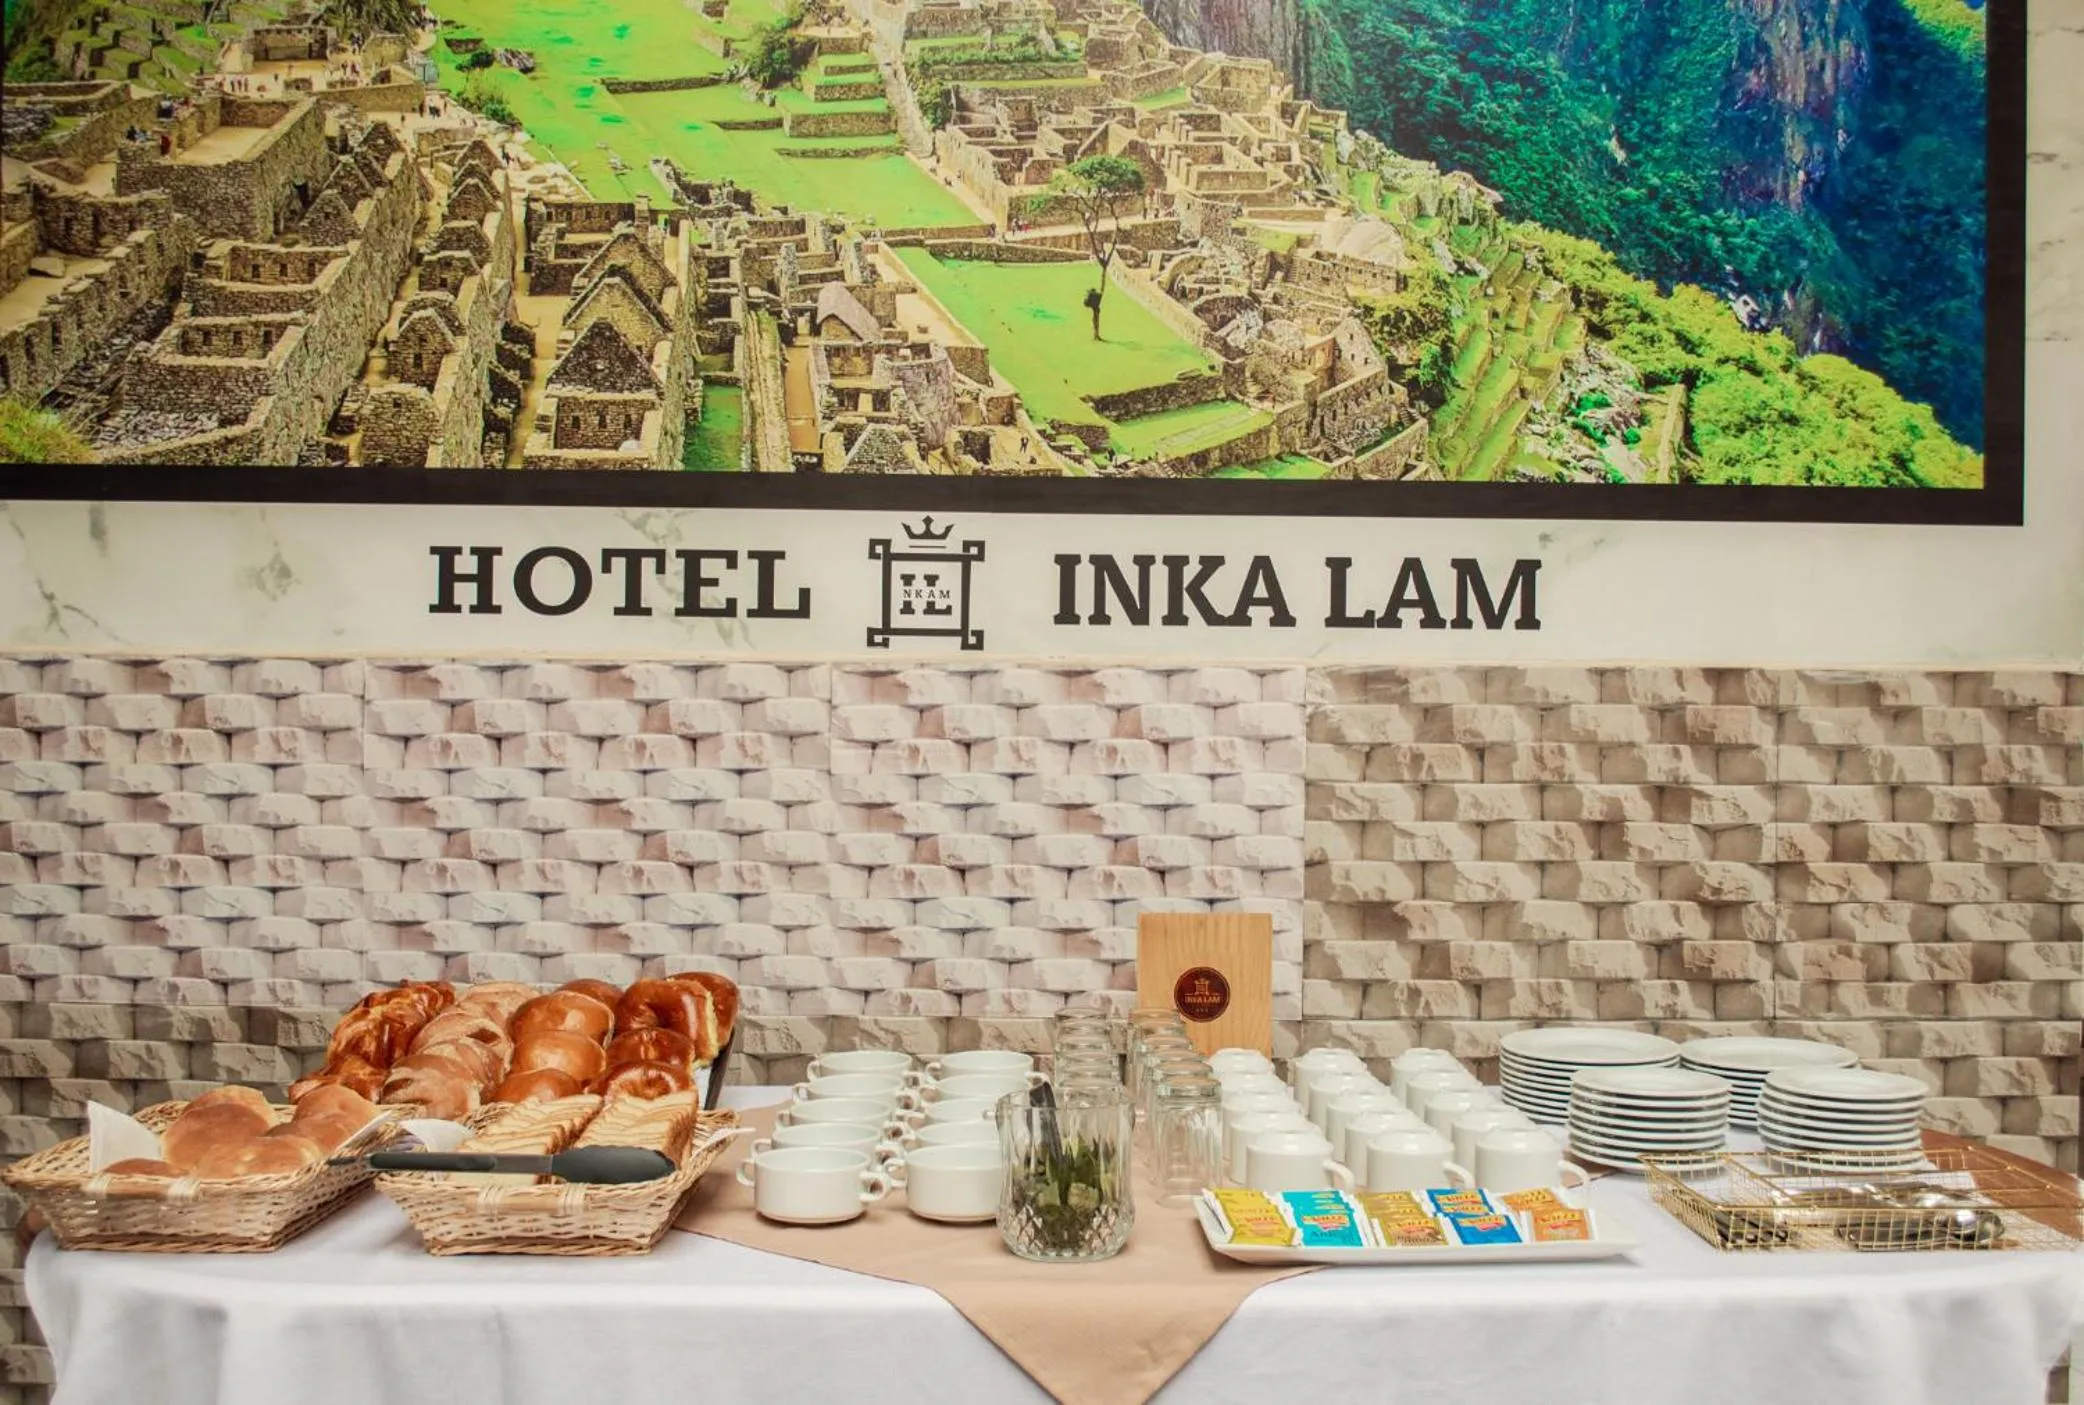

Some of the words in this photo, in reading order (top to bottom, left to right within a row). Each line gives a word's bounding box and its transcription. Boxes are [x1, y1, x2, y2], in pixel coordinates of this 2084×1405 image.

[428, 545, 811, 619] HOTEL
[1053, 554, 1297, 628] INKA
[1324, 556, 1542, 631] LAM
